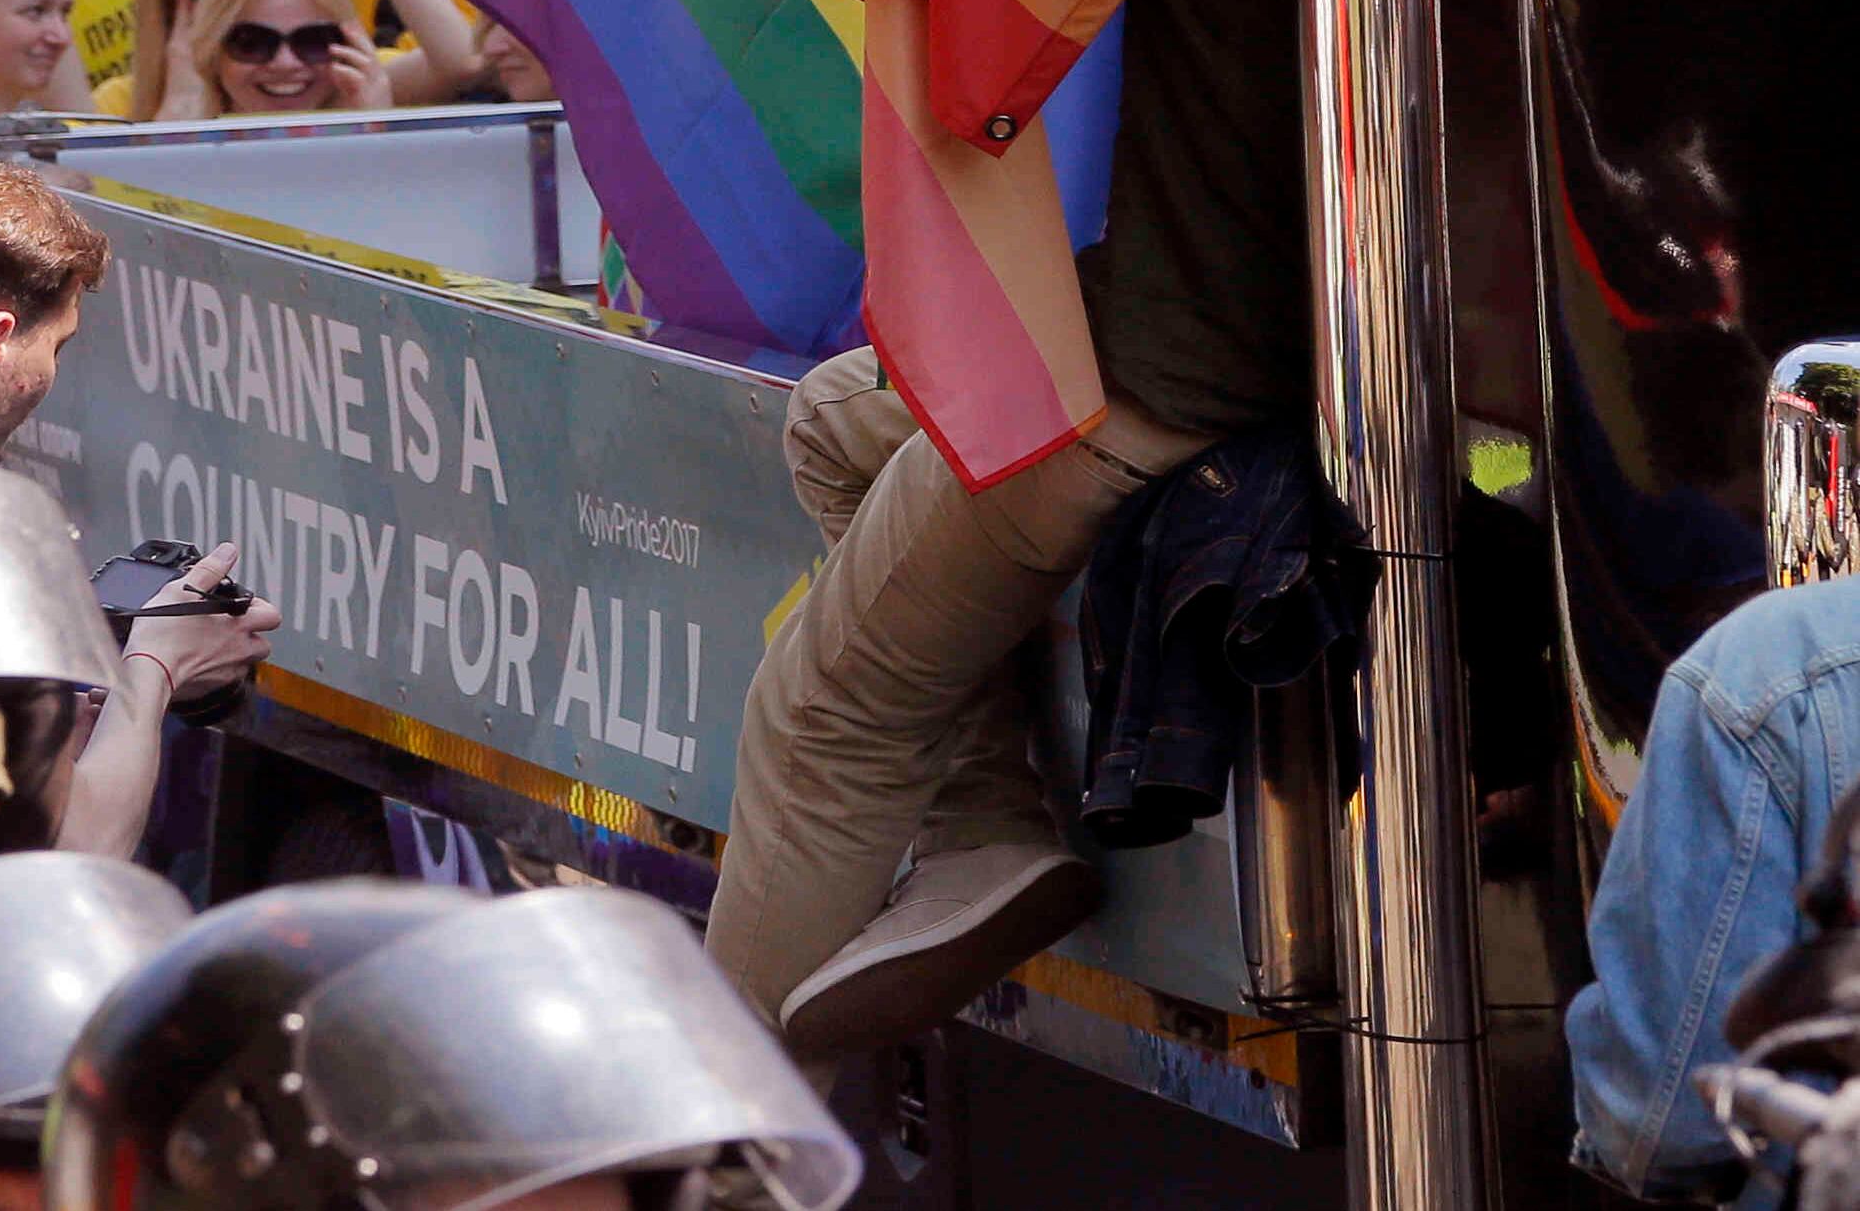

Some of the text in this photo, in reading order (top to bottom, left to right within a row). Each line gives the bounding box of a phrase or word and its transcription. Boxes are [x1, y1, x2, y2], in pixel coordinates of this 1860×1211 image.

[116, 258, 508, 505] UKRAINE IS A
[126, 441, 702, 774] COUNTRY FOR ALL!
[576, 490, 700, 570] KyivPride2017
